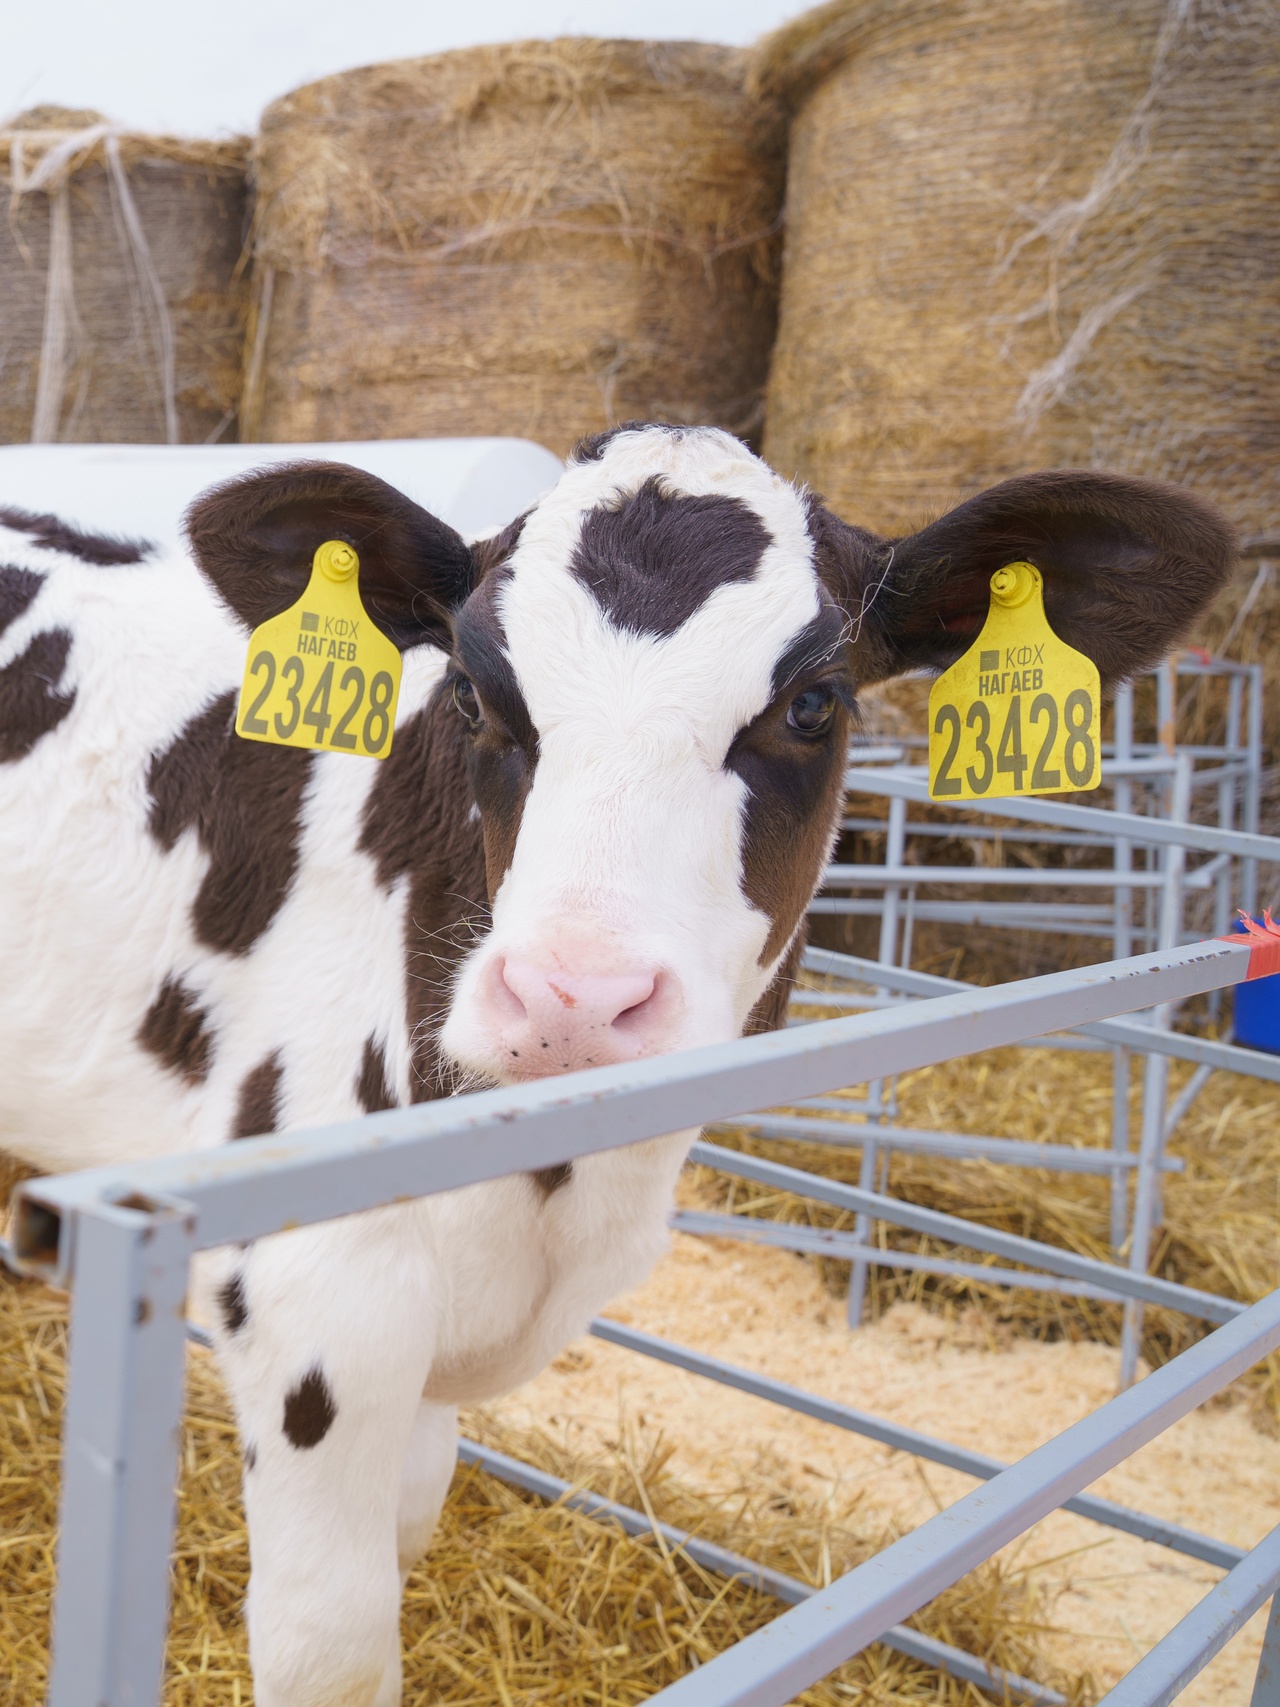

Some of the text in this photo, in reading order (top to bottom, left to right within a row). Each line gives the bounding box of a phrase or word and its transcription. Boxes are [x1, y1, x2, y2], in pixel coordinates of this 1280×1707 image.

[324, 616, 360, 640] КФХ
[297, 634, 357, 661] НАГАЕВ
[1005, 643, 1045, 669] КФХ
[979, 668, 1043, 696] НАГАЕВ
[241, 650, 393, 754] 23428
[932, 689, 1095, 796] 23428
